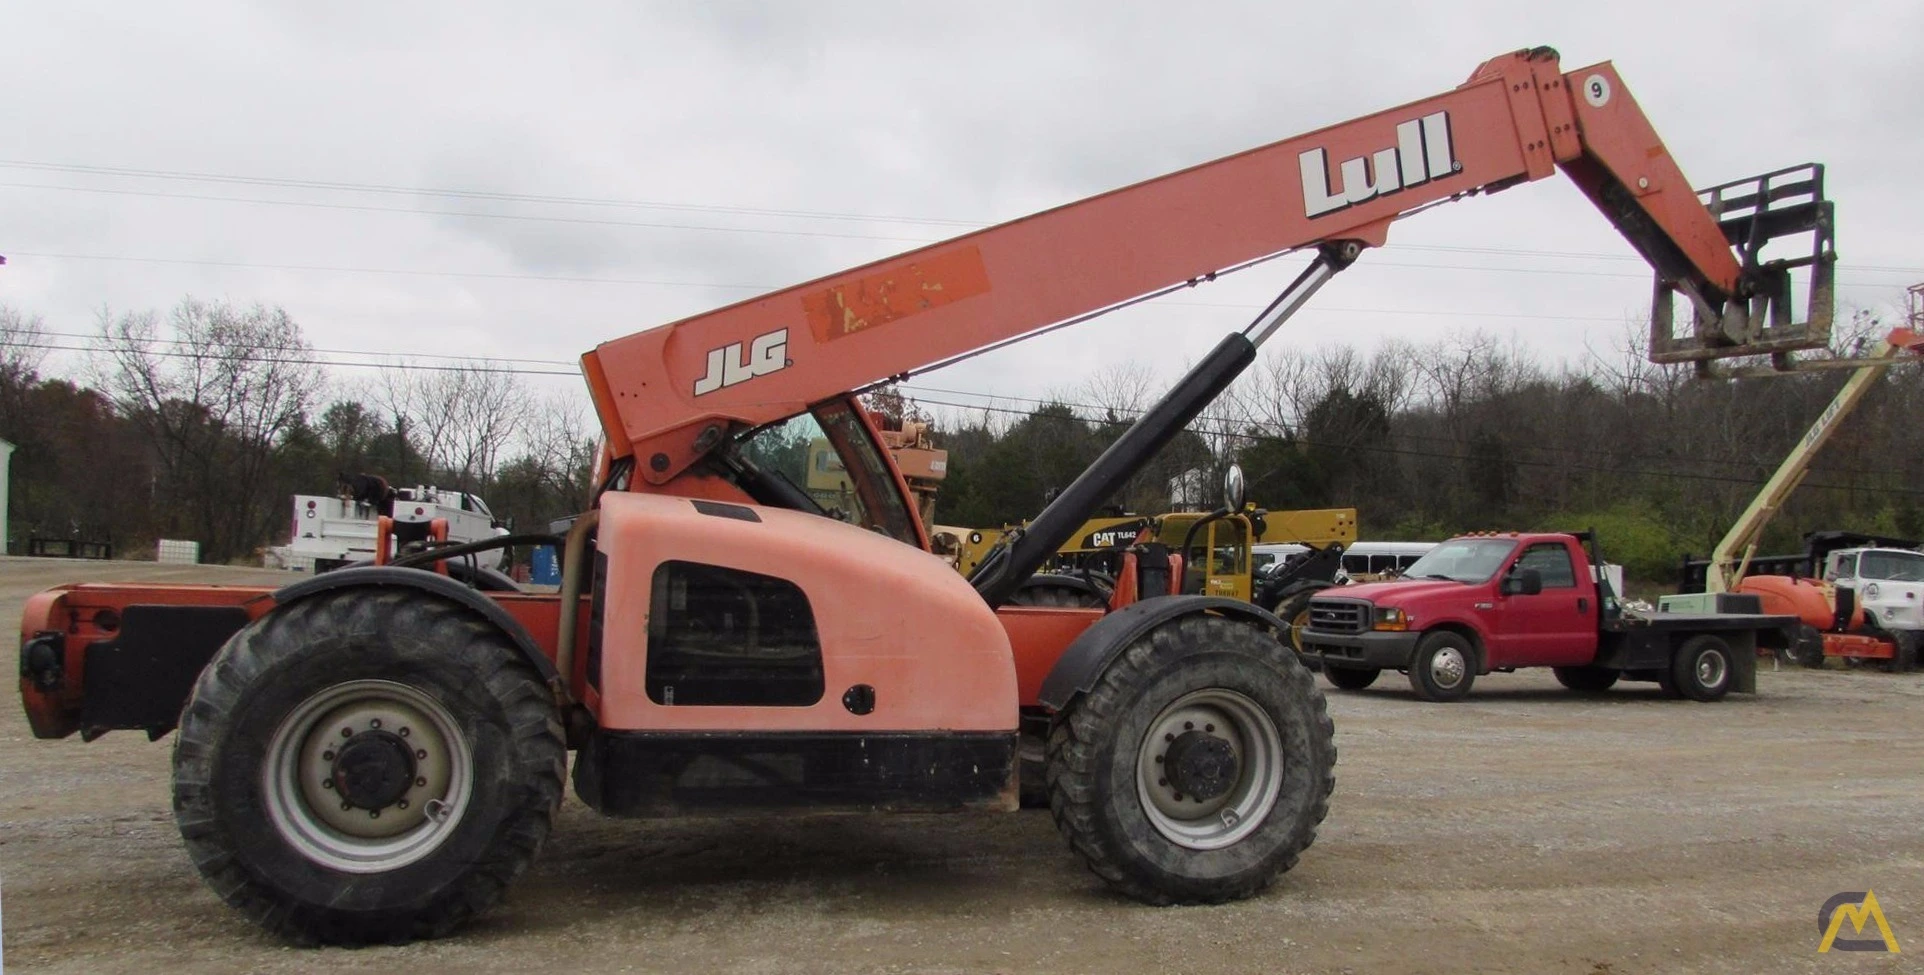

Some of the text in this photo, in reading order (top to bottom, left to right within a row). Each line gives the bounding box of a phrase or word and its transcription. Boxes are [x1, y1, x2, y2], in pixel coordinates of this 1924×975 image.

[1591, 82, 1602, 98] 9
[694, 327, 788, 397] JLG
[1093, 532, 1115, 547] CAT
